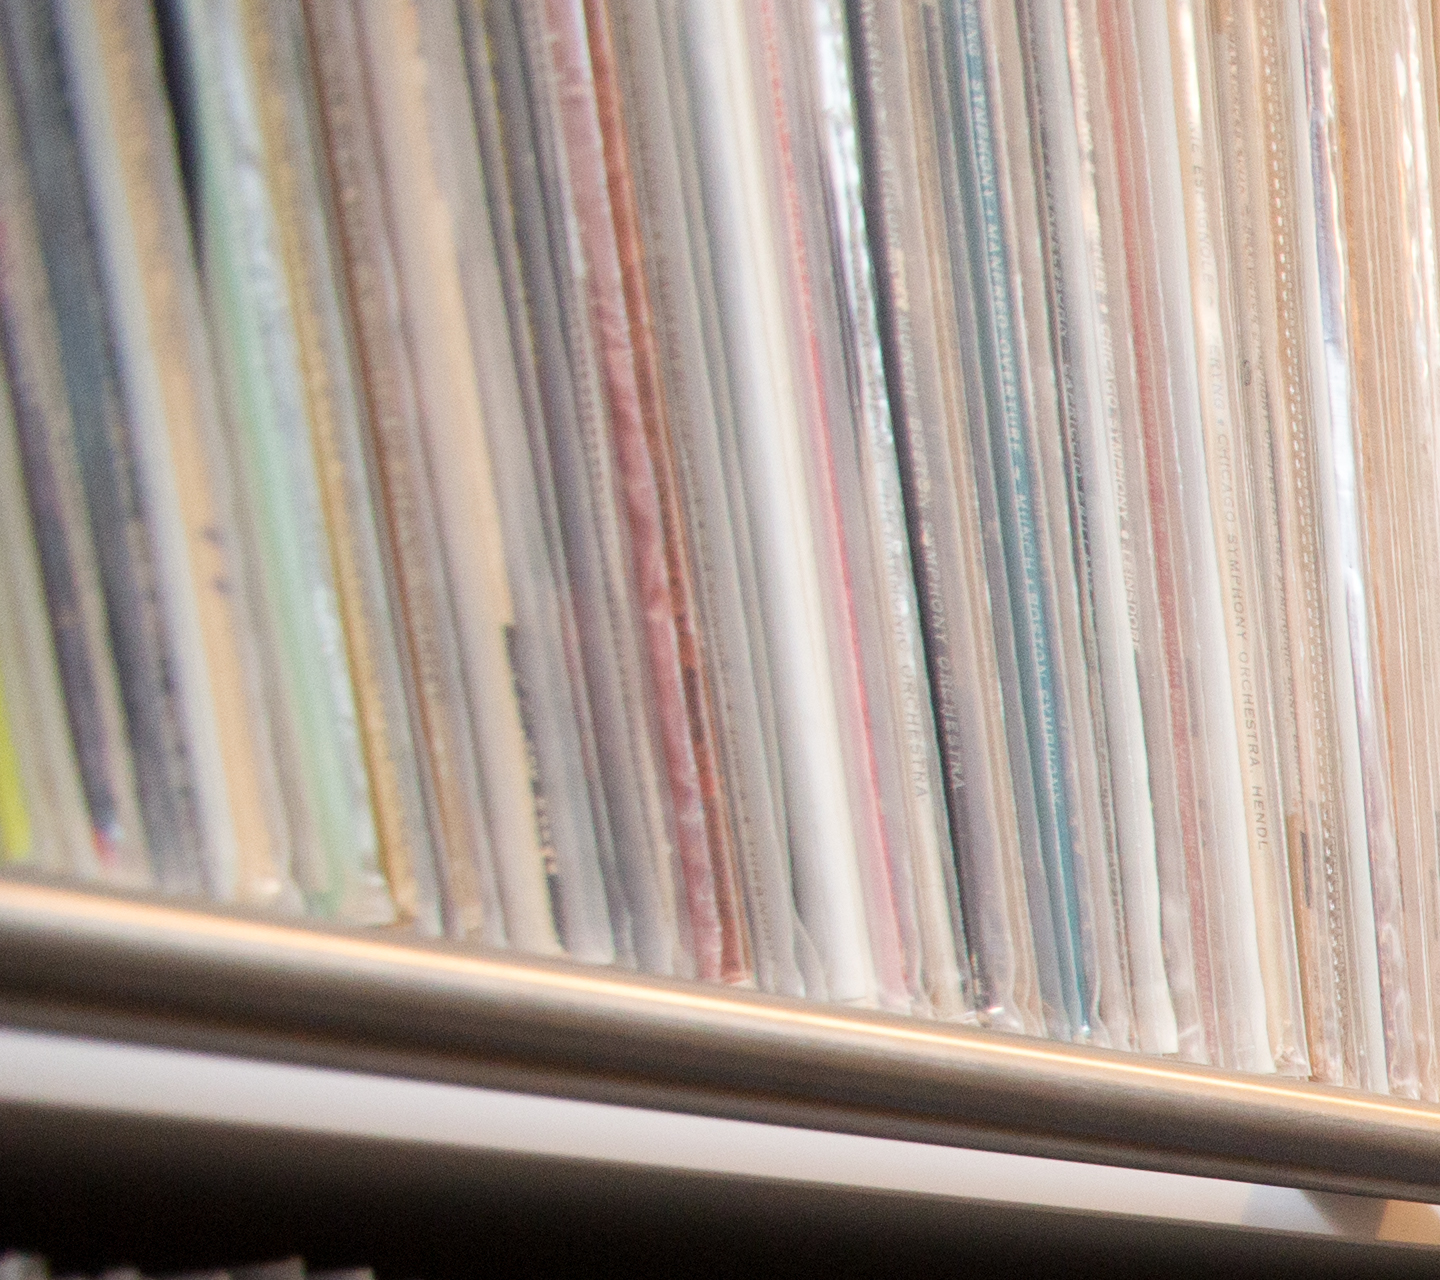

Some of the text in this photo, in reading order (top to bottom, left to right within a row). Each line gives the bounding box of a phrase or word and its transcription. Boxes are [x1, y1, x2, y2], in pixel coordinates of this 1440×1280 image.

[1099, 324, 1116, 406] CHICAGO
[1108, 417, 1127, 520] SYMPHONY
[1216, 433, 1236, 522] CHICAGO
[1225, 533, 1248, 641] SYMPHONY
[939, 656, 965, 789] ORCHESTRA
[1250, 784, 1269, 850] HENDL
